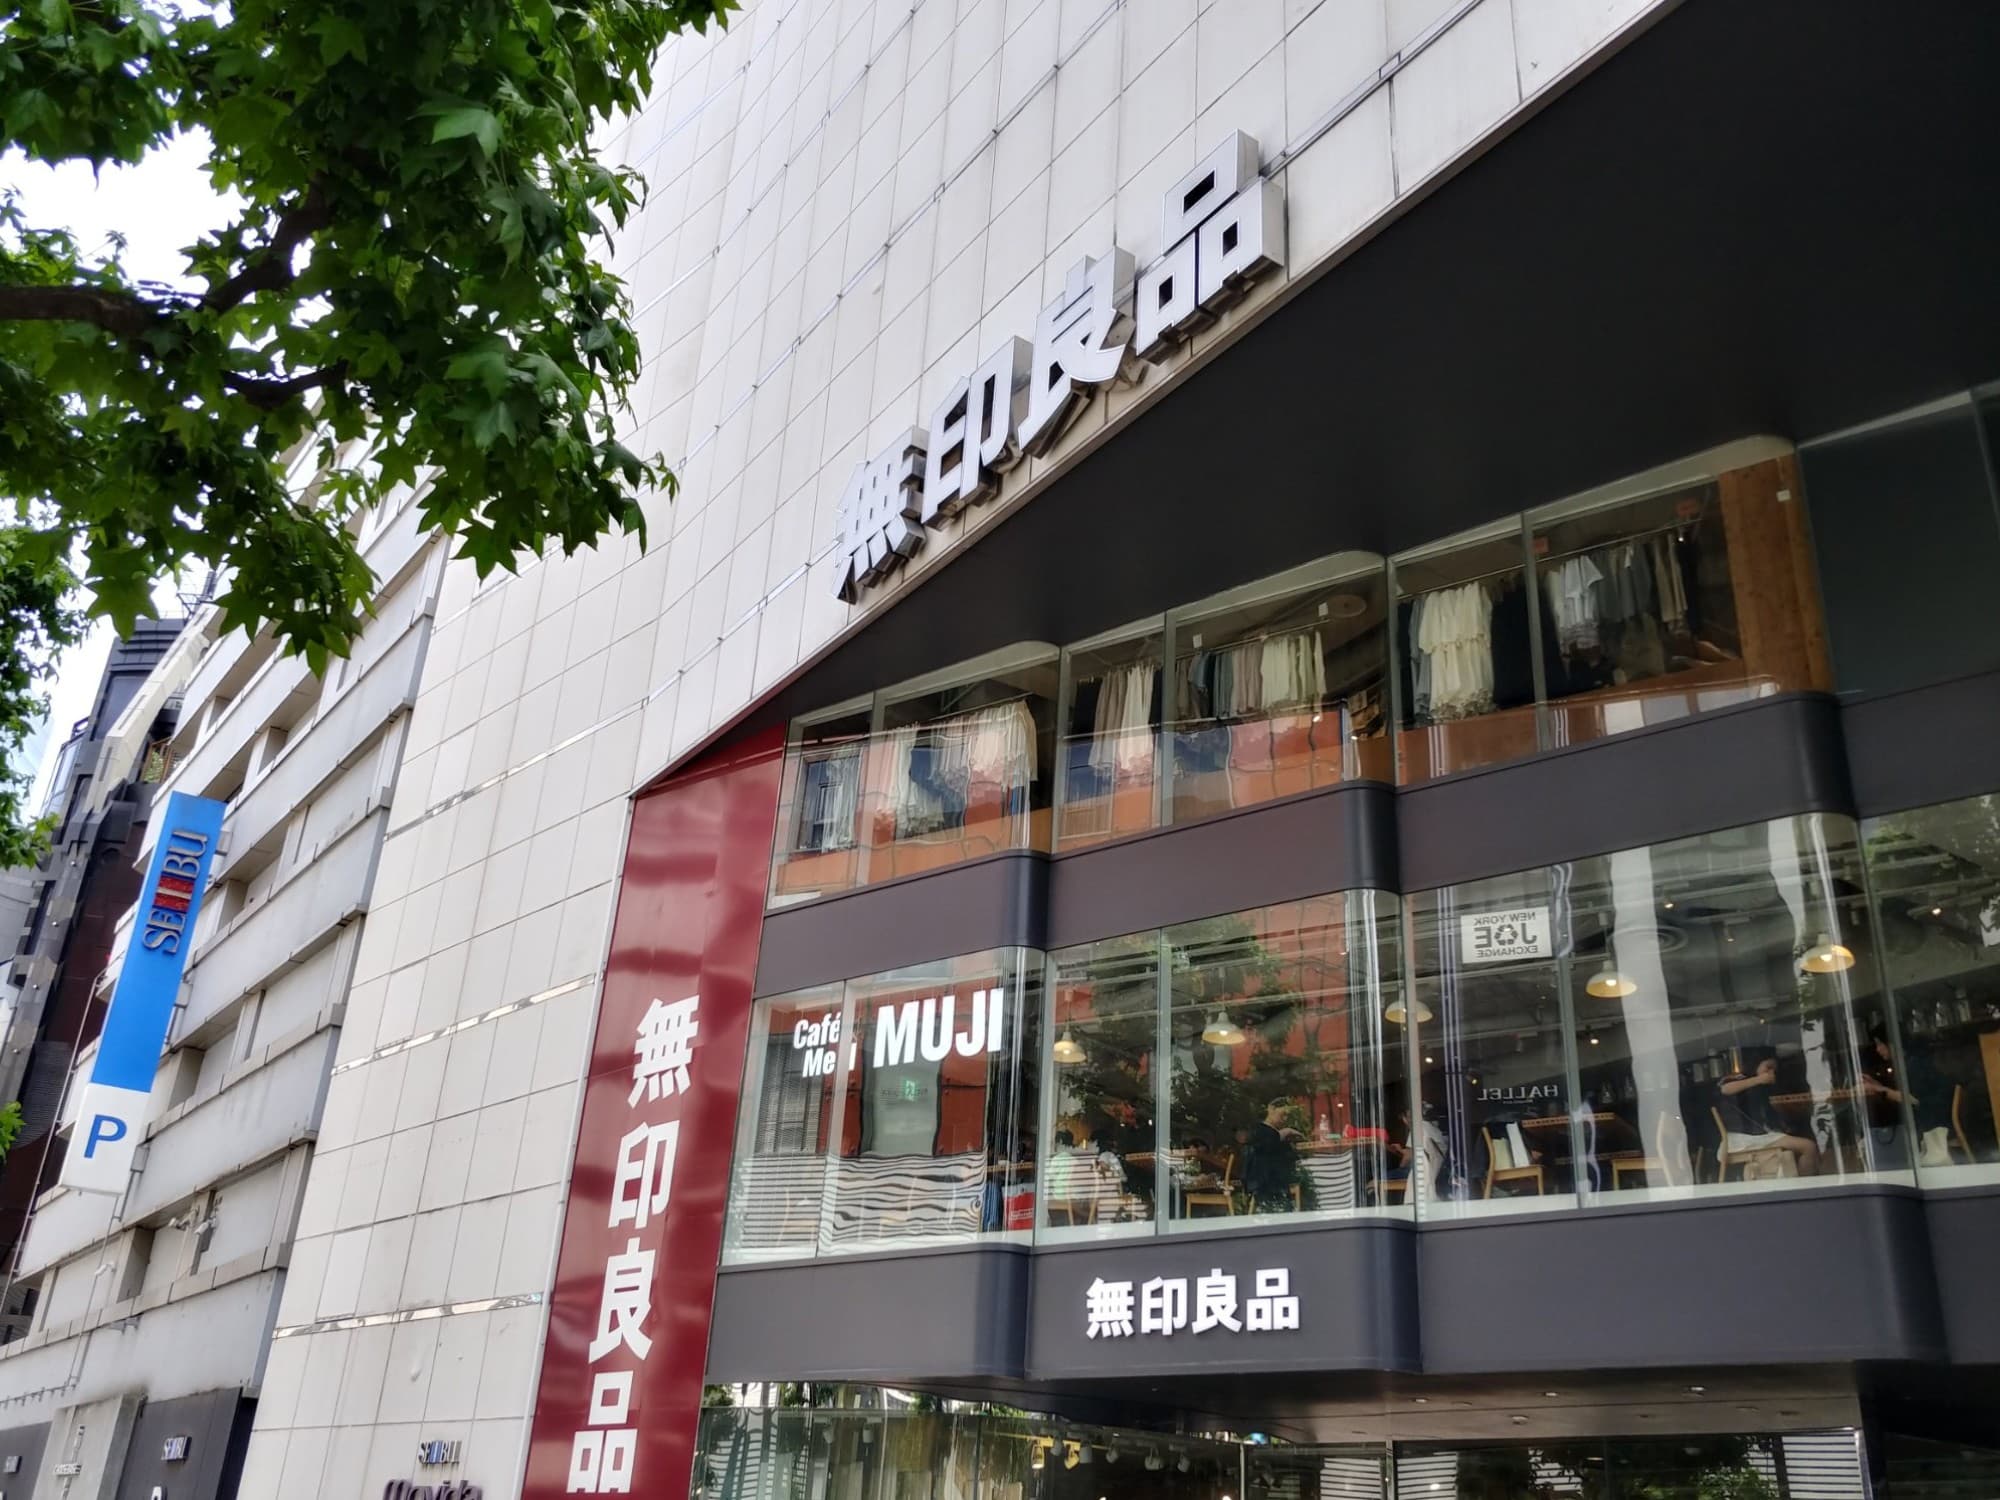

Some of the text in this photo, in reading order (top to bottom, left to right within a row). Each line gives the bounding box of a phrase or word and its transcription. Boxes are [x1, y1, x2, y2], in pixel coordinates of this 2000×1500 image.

[833, 129, 1284, 603] 無印良品
[142, 830, 208, 953] SEIBU
[793, 1011, 842, 1049] Café
[801, 1042, 857, 1078] Mel
[872, 987, 1004, 1068] MUJI
[84, 1114, 127, 1158] P
[566, 995, 699, 1494] 無印良品
[1086, 1268, 1299, 1339] 無印良品
[418, 1440, 461, 1465] SEIBU
